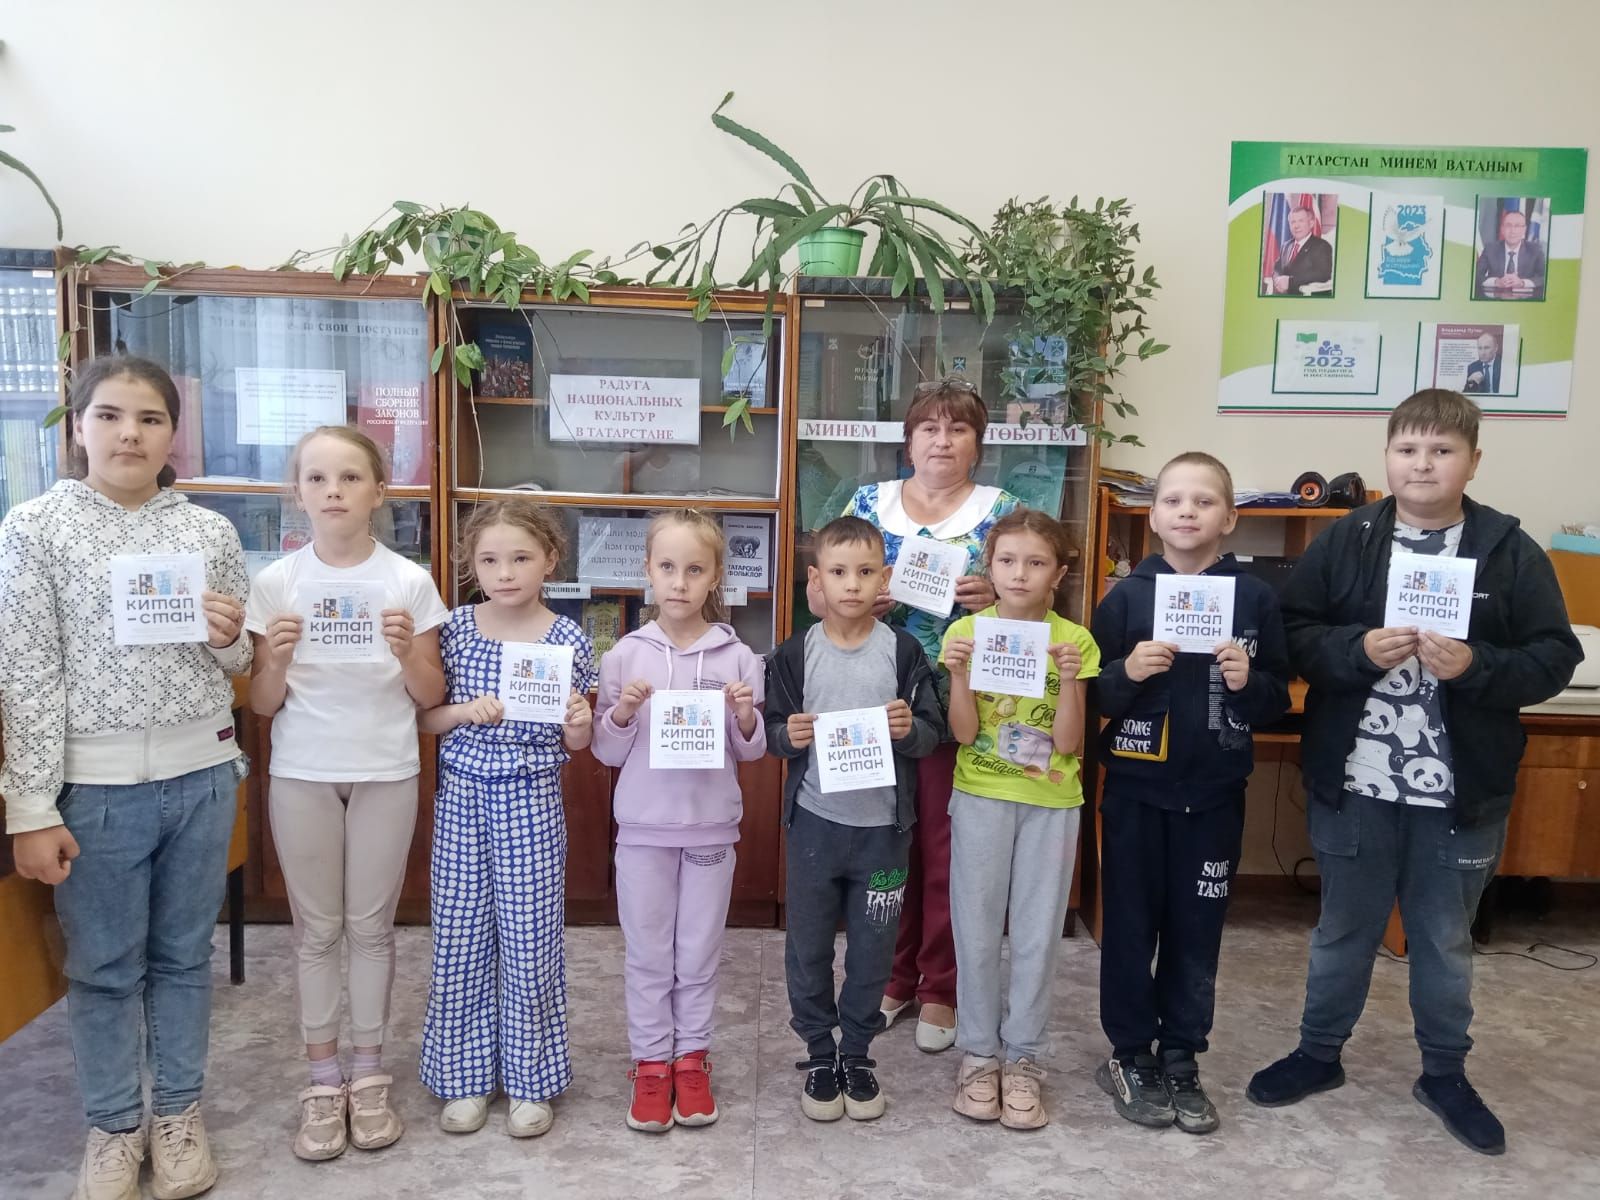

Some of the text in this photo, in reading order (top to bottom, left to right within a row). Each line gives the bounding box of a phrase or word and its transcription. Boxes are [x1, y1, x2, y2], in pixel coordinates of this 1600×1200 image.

[1287, 153, 1523, 173] ТАТАРСТАН МИНЕМ ВАТАНЫМ
[1397, 204, 1427, 216] 2023
[356, 325, 419, 337] поступки
[1304, 356, 1356, 368] 2023
[375, 386, 419, 397] ПОЛНЫЙ
[599, 378, 651, 391] РАДУГА
[375, 398, 420, 407] СБОРНИК
[567, 394, 683, 408] НАЦИОНАЛЬНЫХ
[375, 409, 420, 418] ЗАКОНОВ
[594, 410, 656, 422] КУЛЬТУР
[575, 427, 674, 441] В ТАТАРСТАНЕ
[804, 423, 877, 438] МИНЕМ
[988, 427, 1077, 442] ТӨБӘГЕМ
[624, 544, 648, 552] горе
[728, 564, 763, 572] ТАТАРСКИЙ
[902, 567, 950, 588] китап
[899, 578, 948, 598] -стан
[1397, 590, 1460, 608] китап
[1472, 592, 1490, 600] ORT
[124, 597, 194, 611] китап
[127, 610, 195, 624] -стан
[1164, 611, 1223, 625] китап
[1397, 605, 1460, 621] -стан
[309, 621, 373, 633] китап
[1164, 623, 1222, 637] -стан
[309, 633, 373, 645] -стан
[981, 654, 1037, 669] китап
[981, 665, 1036, 681] -стан
[508, 680, 562, 694] китап
[508, 693, 561, 707] -стан
[660, 727, 715, 739] китап
[1120, 718, 1152, 737] SONG
[660, 739, 715, 752] -стан
[1113, 734, 1152, 754] TASTE
[827, 745, 883, 763] китап
[828, 758, 885, 774] -стан
[1200, 860, 1230, 878] SONG
[1196, 879, 1230, 898] TASTE
